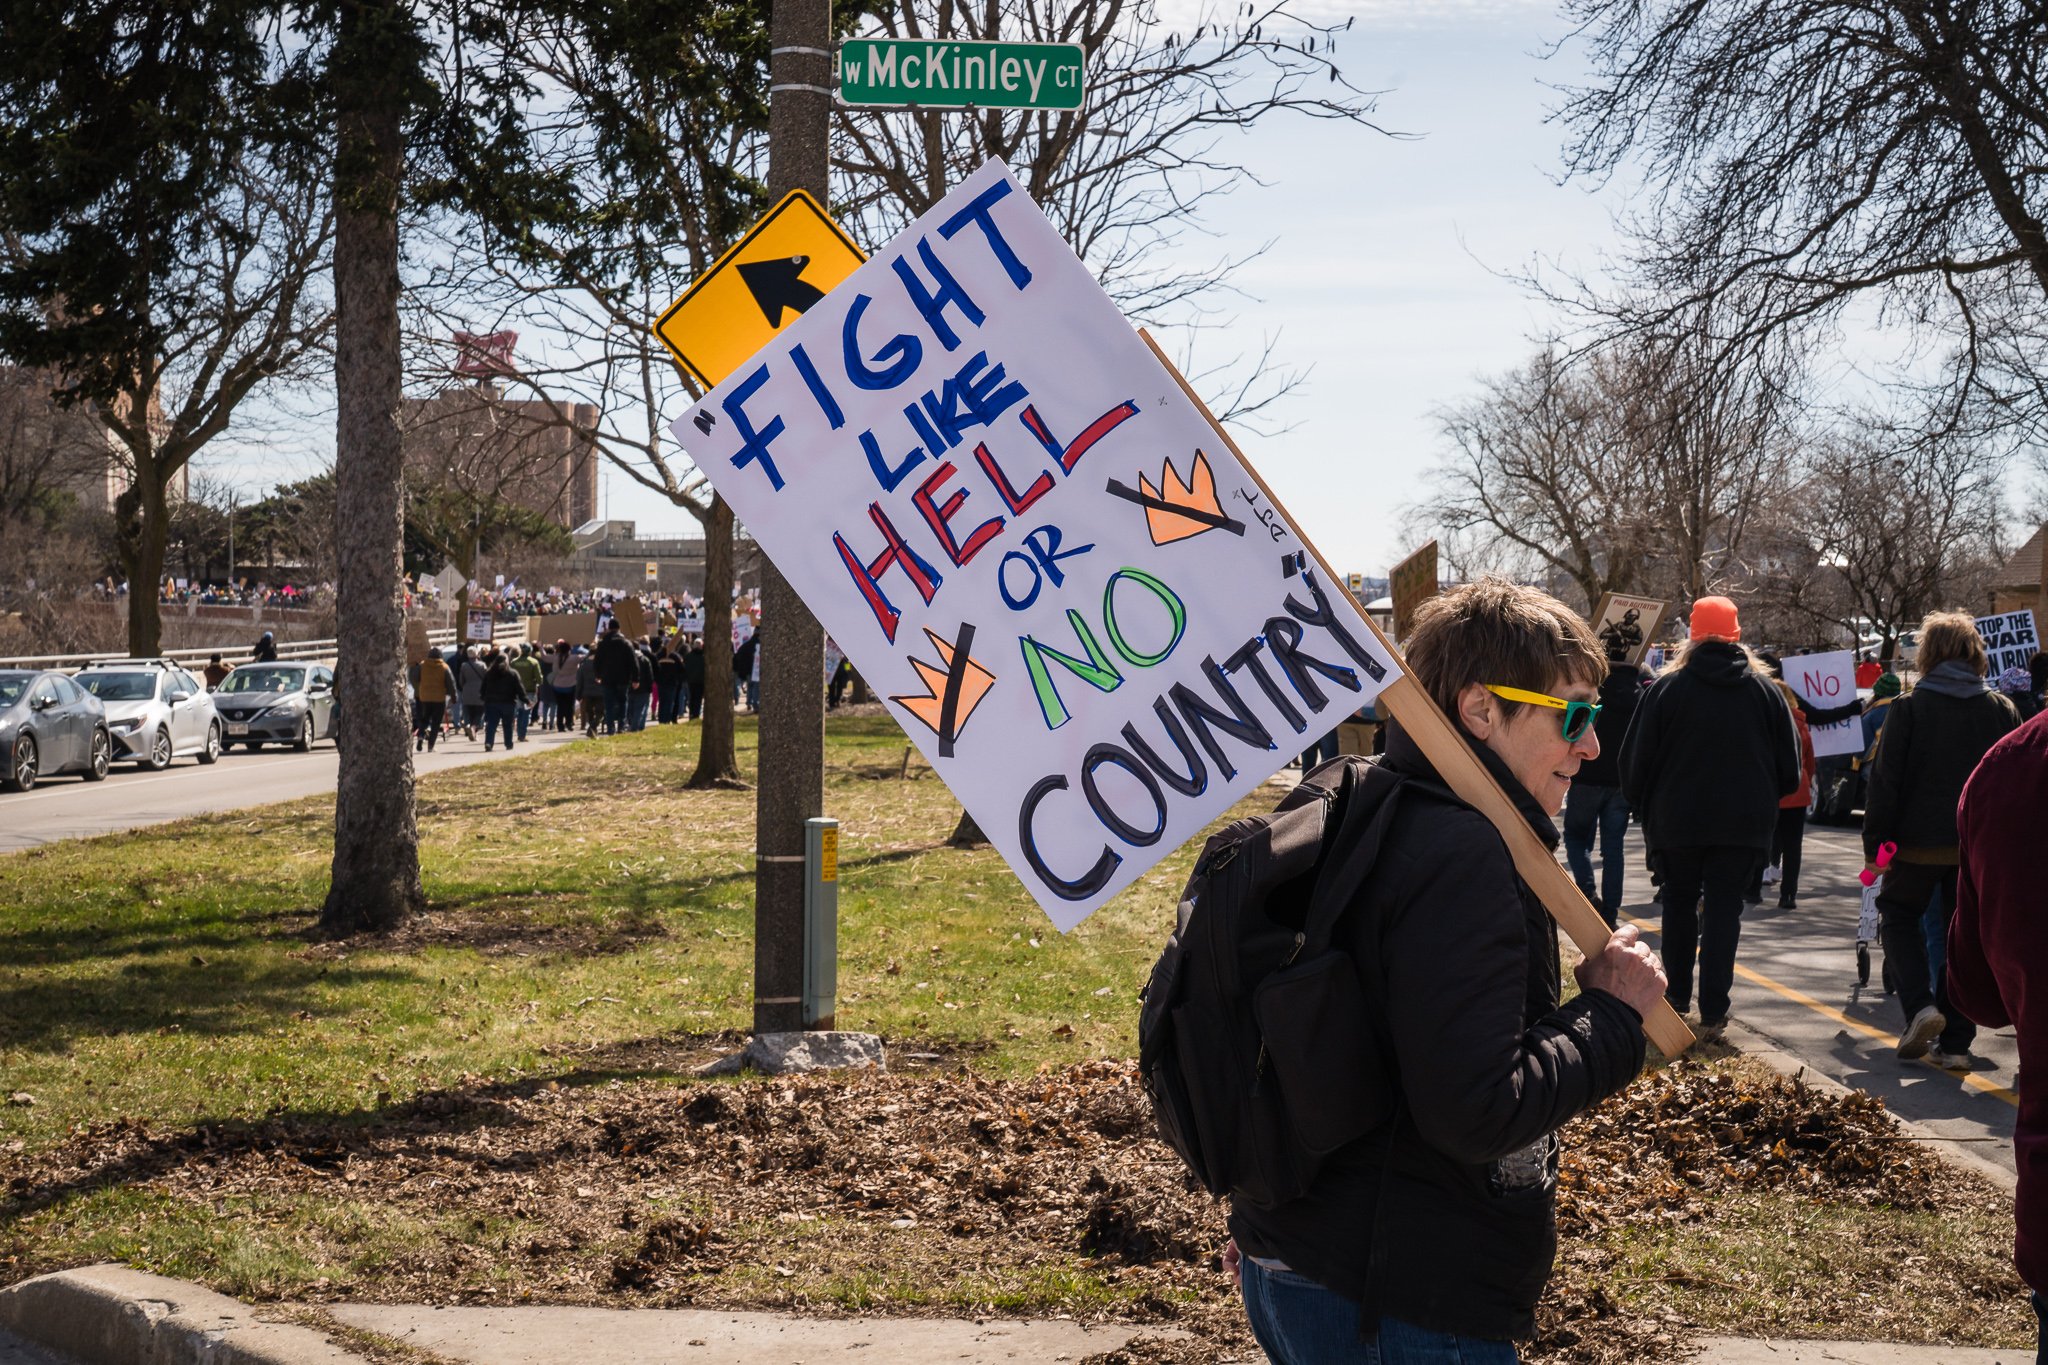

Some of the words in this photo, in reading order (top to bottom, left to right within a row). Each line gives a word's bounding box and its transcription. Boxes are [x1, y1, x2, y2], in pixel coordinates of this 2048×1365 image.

[845, 62, 862, 84] W
[868, 45, 1047, 103] McKinley
[1055, 65, 1079, 88] CT
[858, 350, 1029, 492] LIKE
[832, 399, 1141, 645] HELL
[997, 524, 1095, 611] OR
[1018, 566, 1187, 730] NO
[2007, 613, 2031, 630] THE
